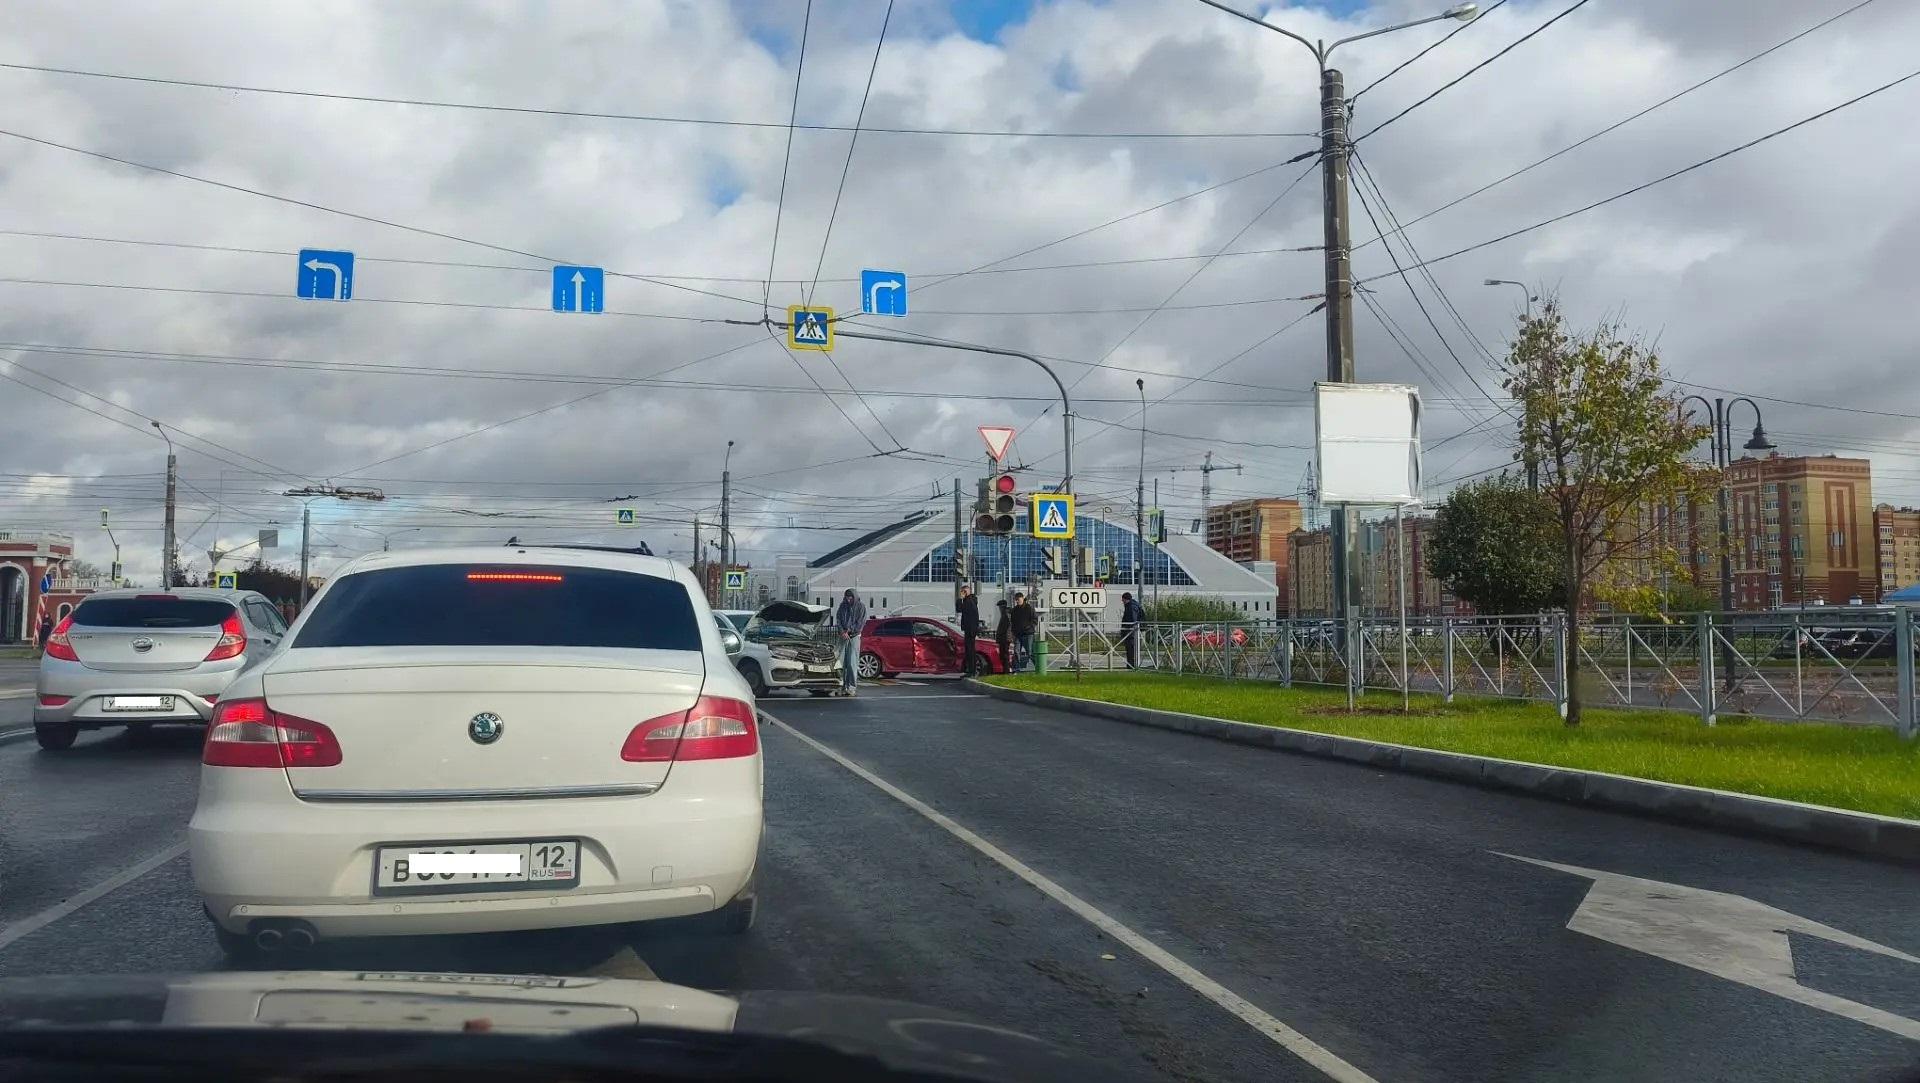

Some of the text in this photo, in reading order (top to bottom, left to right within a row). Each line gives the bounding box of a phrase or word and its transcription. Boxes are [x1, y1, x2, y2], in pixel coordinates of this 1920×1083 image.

[1059, 591, 1100, 605] СТОП
[535, 845, 566, 868] 12
[531, 868, 555, 878] RUS
